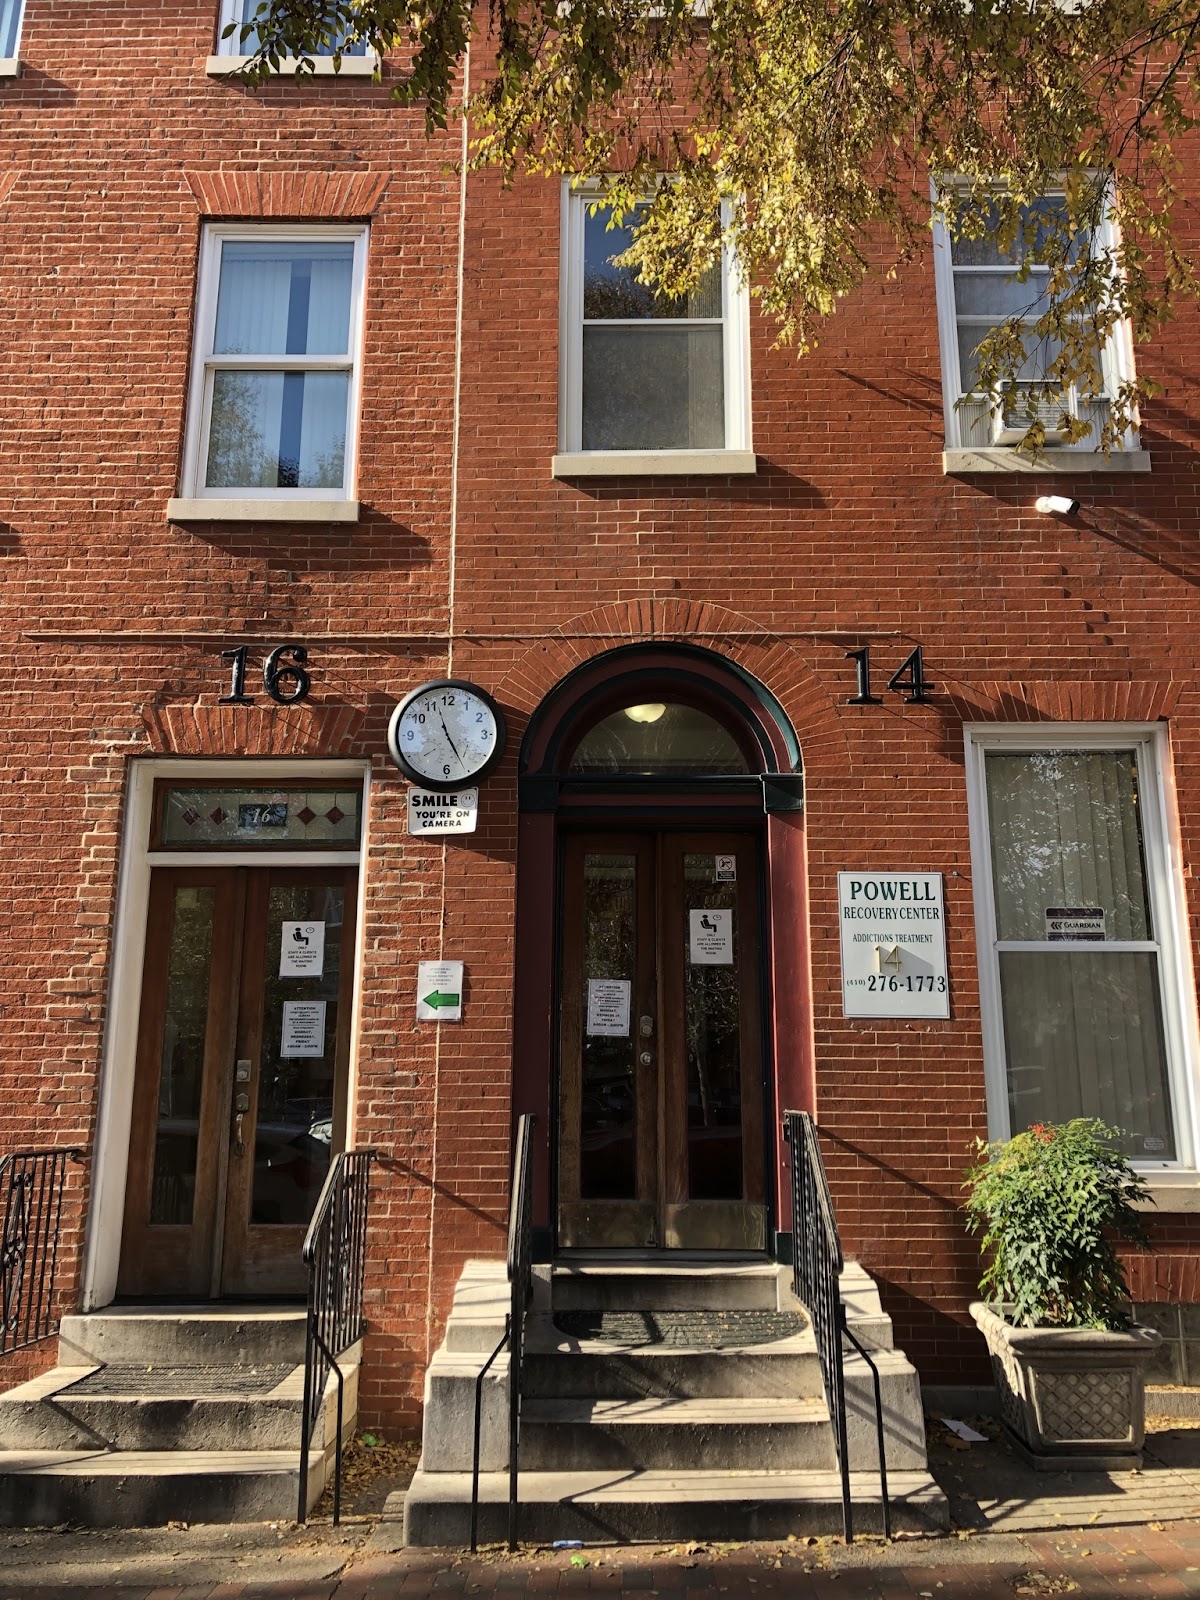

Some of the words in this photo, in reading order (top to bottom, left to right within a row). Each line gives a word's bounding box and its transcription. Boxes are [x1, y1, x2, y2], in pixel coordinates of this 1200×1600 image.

[218, 644, 310, 703] 16
[845, 645, 935, 704] 14
[441, 695, 455, 706] 12
[463, 701, 469, 711] 1
[424, 701, 437, 712] 11
[412, 713, 426, 724] 10
[475, 712, 483, 723] 2
[406, 730, 414, 741] 9
[480, 729, 488, 740] 3
[442, 764, 451, 775] 6
[411, 795, 458, 807] SMILE
[253, 808, 271, 823] 16
[416, 810, 451, 818] YOU'RE
[422, 820, 462, 828] CAMERA
[850, 881, 936, 900] POWELL
[844, 907, 898, 919] RECOVERY
[899, 907, 940, 919] CENTER
[853, 934, 893, 943] ADDICTIONS
[895, 934, 933, 943] TREATMENT
[875, 945, 902, 973] 14
[867, 975, 946, 992] 276-1773
